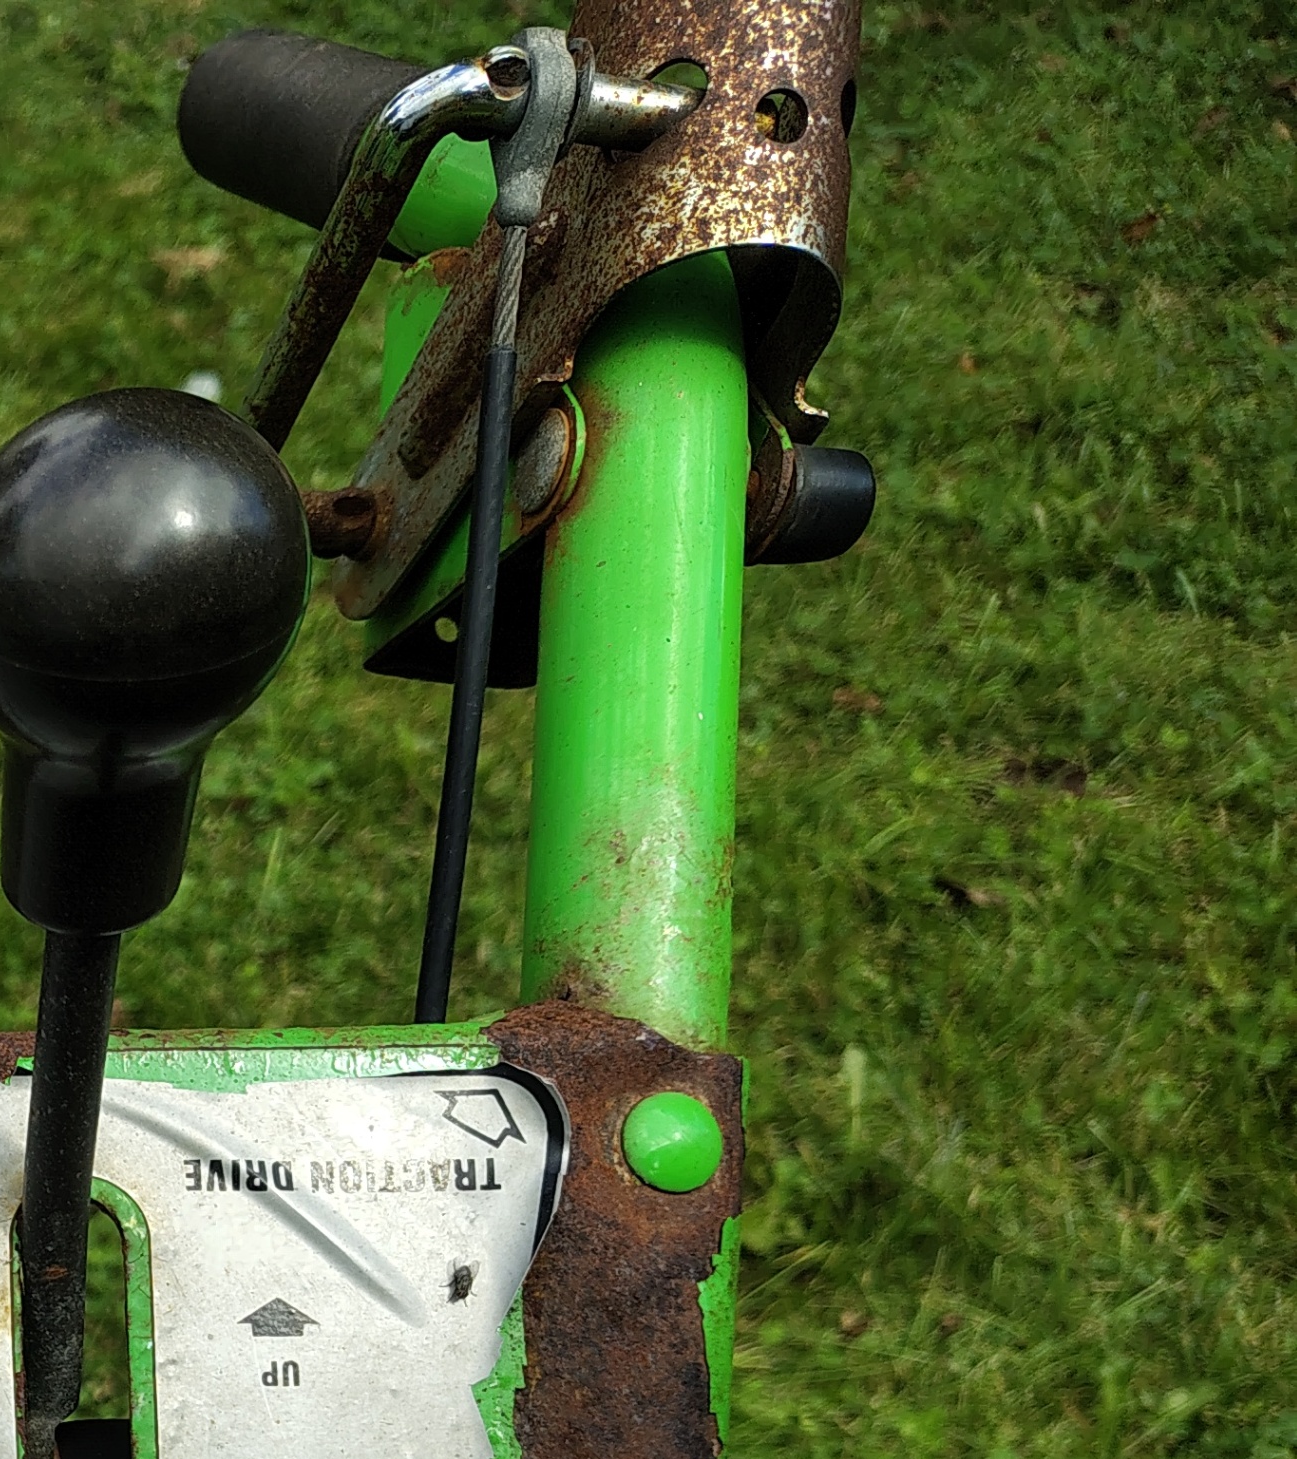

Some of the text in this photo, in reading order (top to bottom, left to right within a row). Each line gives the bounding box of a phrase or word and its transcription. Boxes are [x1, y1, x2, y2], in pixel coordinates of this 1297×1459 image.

[183, 1157, 502, 1193] TRACTION DRIVE
[261, 1360, 300, 1387] UP
